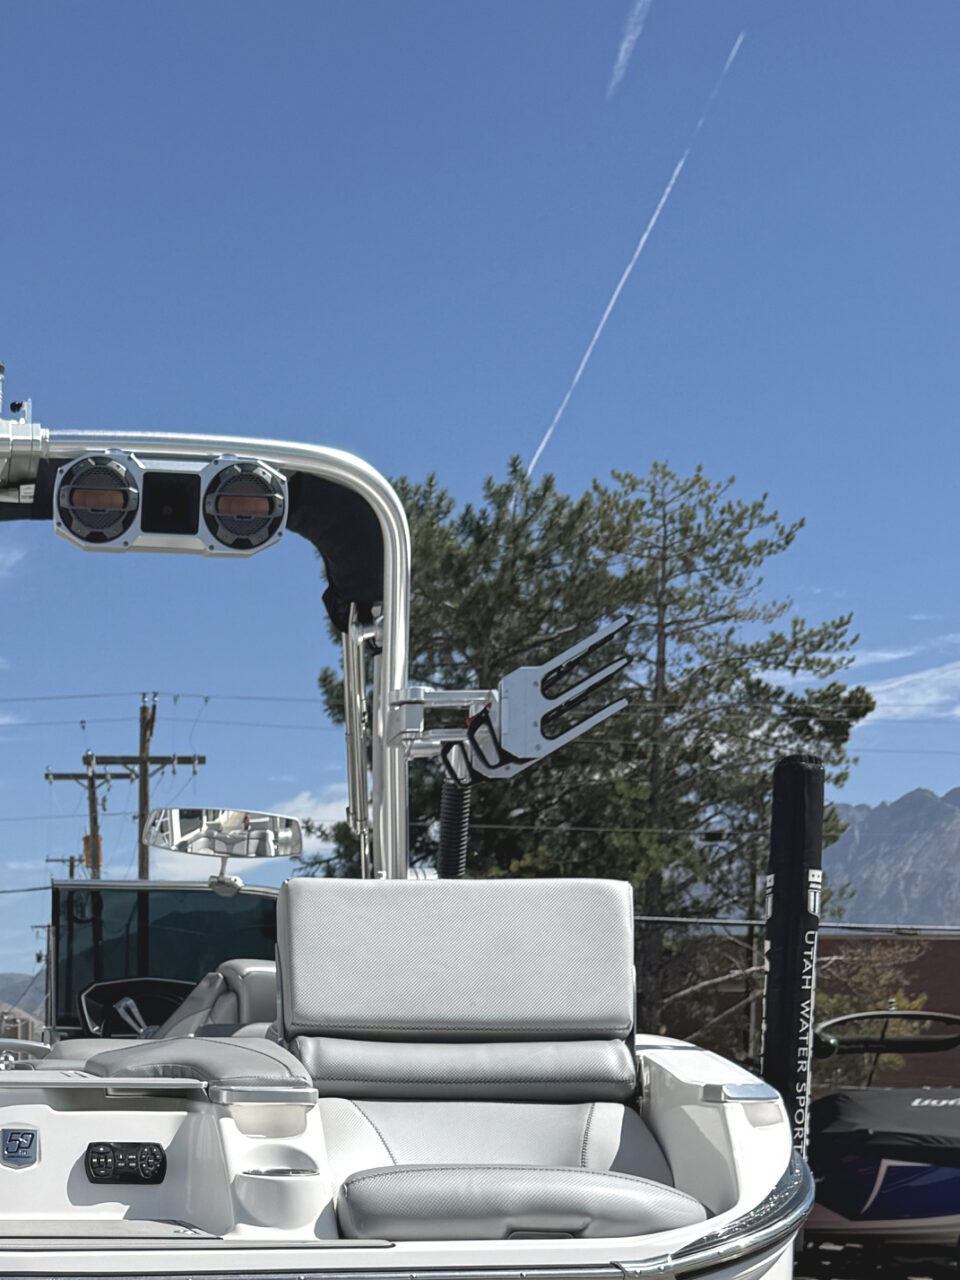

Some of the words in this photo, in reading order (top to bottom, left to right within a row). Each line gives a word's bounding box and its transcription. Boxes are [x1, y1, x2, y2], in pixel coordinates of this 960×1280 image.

[800, 930, 815, 990] UTAH
[796, 1000, 811, 1073] WATER
[792, 1082, 807, 1153] SPORT
